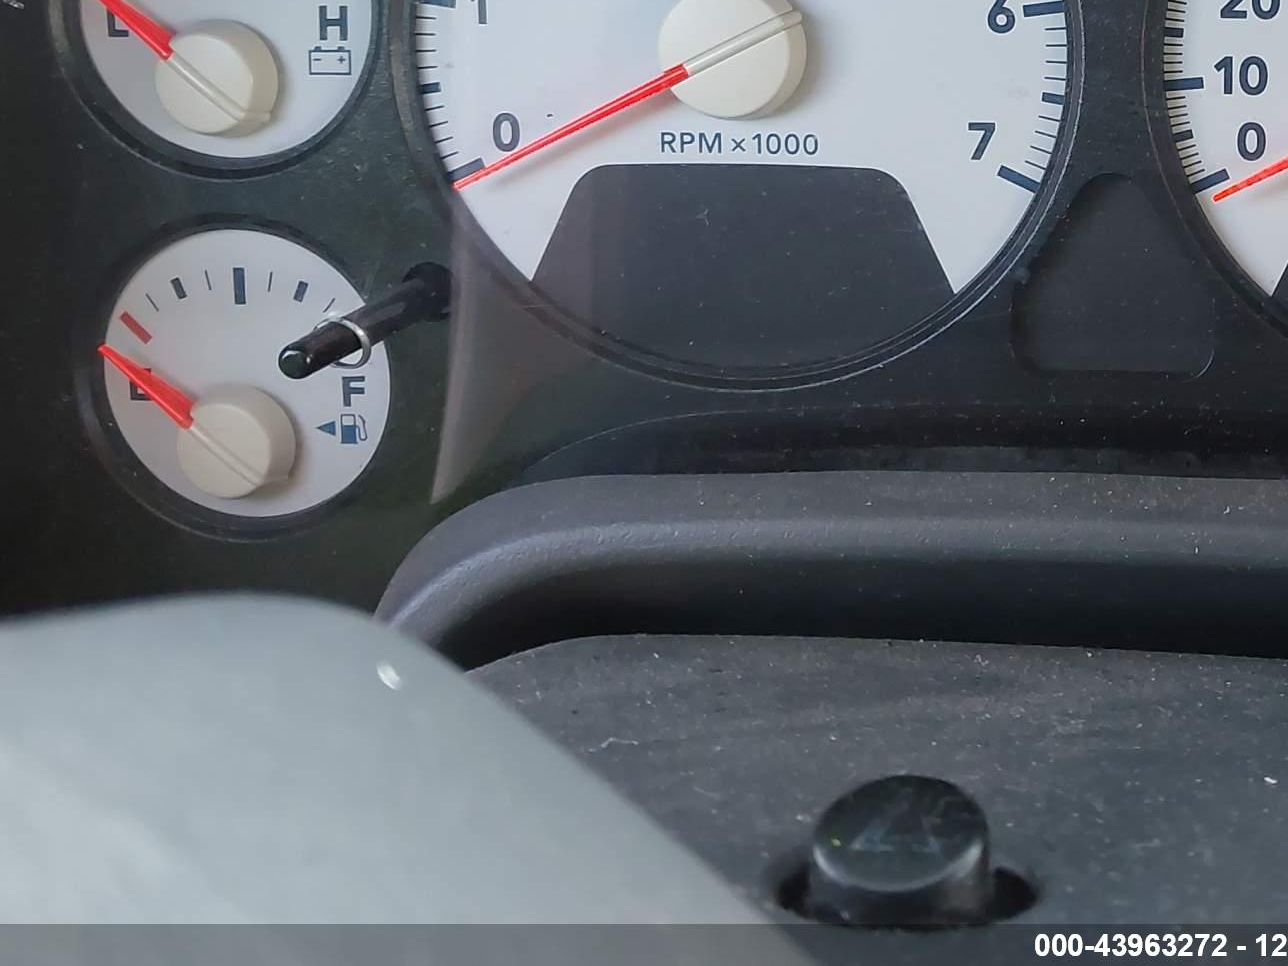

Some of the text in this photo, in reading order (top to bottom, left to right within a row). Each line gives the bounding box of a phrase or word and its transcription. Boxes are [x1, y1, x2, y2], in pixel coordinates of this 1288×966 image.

[319, 6, 349, 41] H
[1214, 56, 1268, 95] 10
[492, 113, 520, 152] 0
[660, 132, 723, 154] RPM
[968, 122, 996, 160] 7
[1237, 122, 1267, 161] 0
[341, 375, 366, 407] F
